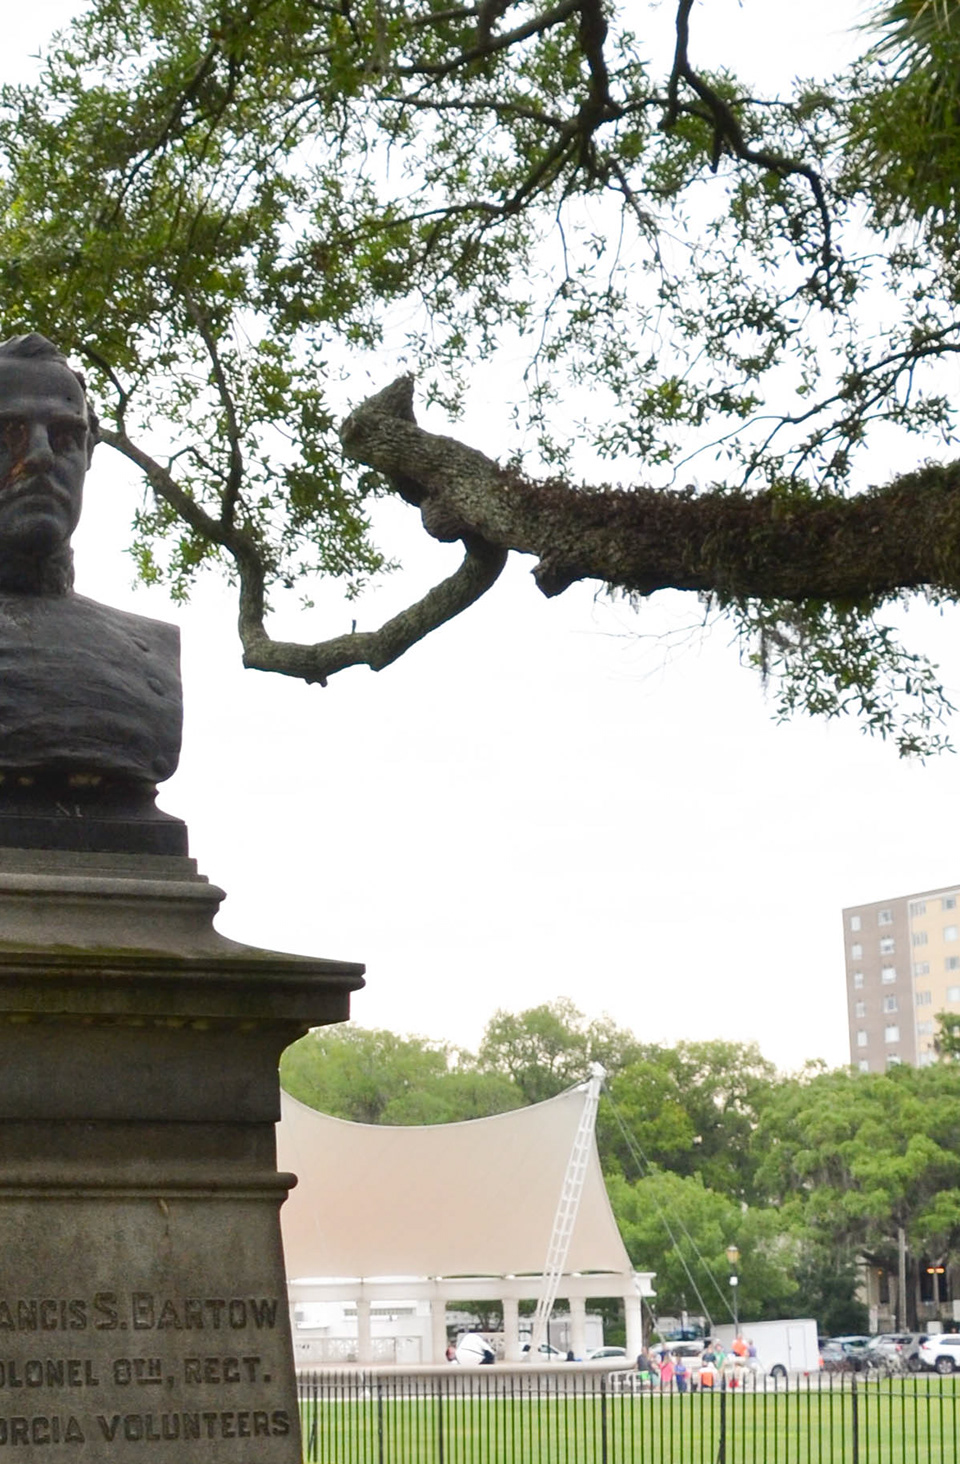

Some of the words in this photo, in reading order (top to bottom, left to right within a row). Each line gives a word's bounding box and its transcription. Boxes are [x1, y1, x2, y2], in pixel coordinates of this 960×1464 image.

[93, 1291, 127, 1331] S.
[132, 1291, 278, 1330] BARTOW
[96, 1409, 291, 1442] VOLUNTEERS
